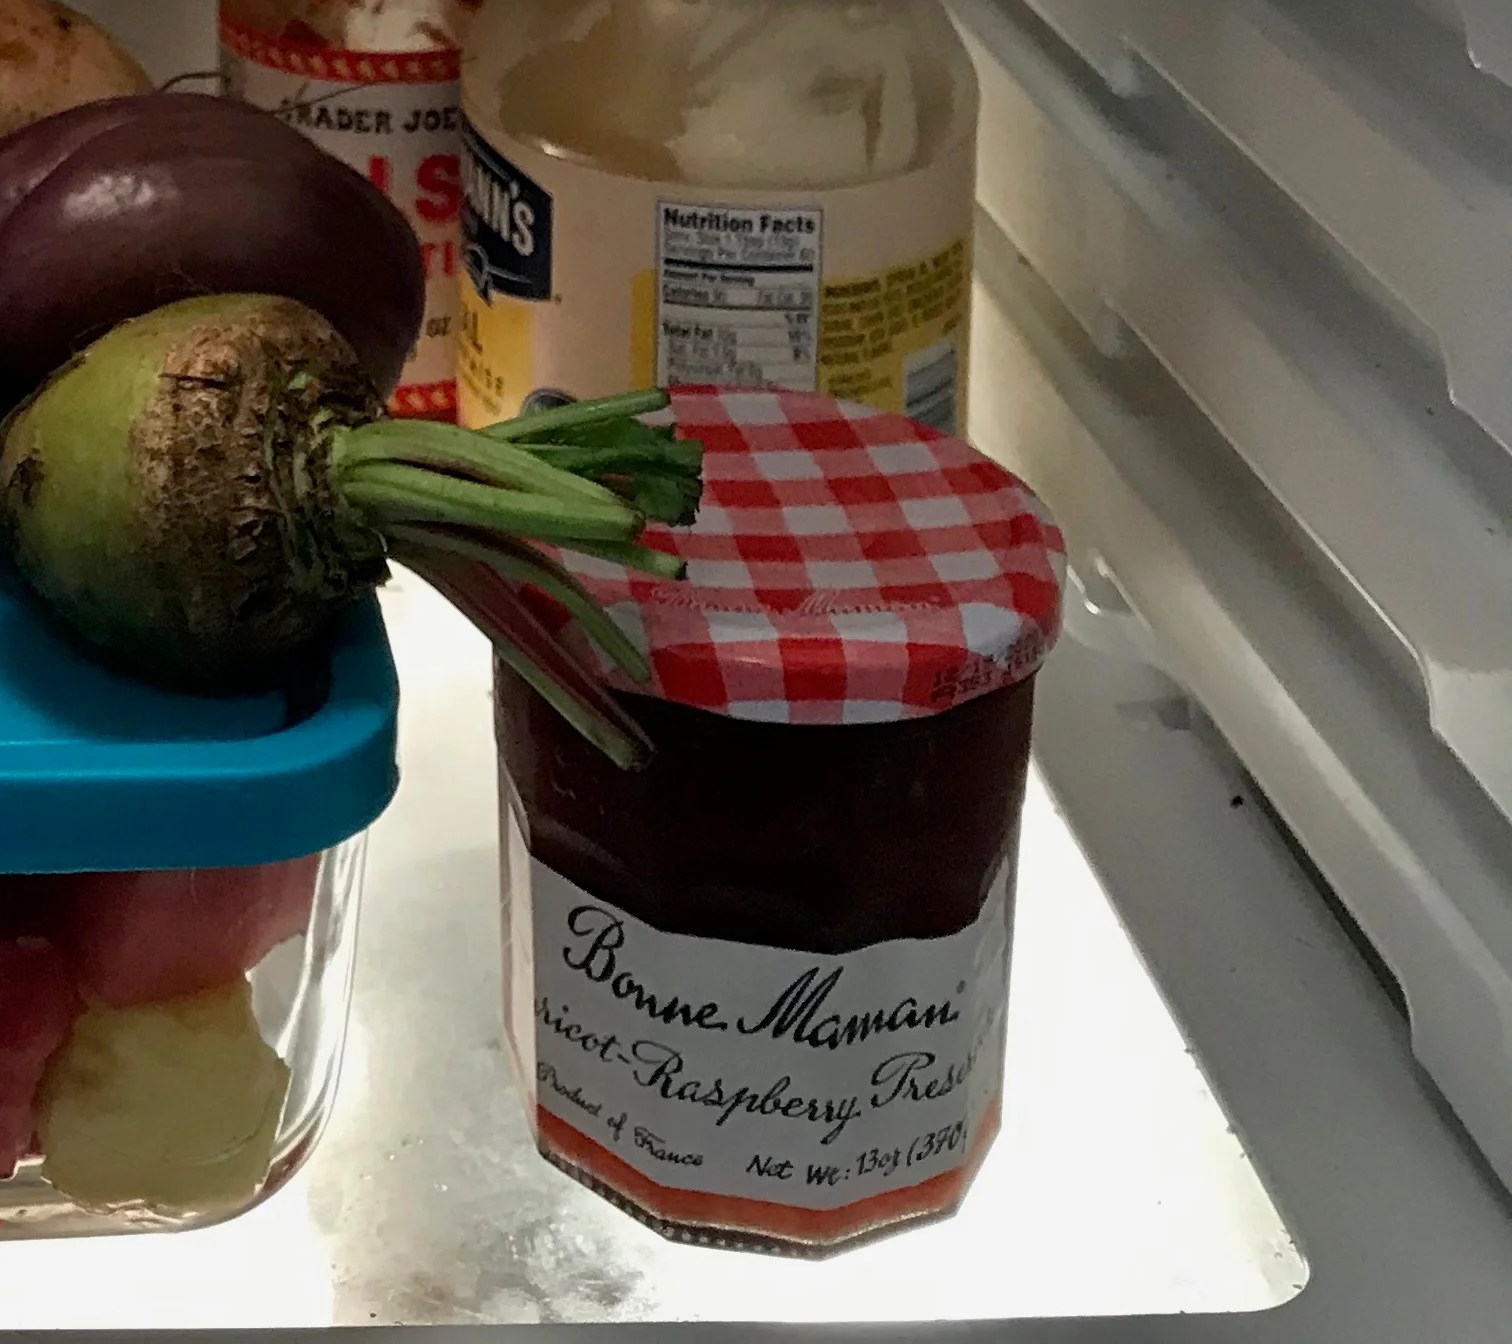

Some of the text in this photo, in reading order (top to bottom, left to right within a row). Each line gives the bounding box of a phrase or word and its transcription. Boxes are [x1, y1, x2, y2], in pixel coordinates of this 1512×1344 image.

[663, 206, 817, 235] Nutrition Facts
[563, 905, 962, 1051] Bonne Maman
[535, 997, 862, 1145] ricot-Raspberry
[537, 1061, 706, 1168] Product of France
[745, 1154, 795, 1181] Net
